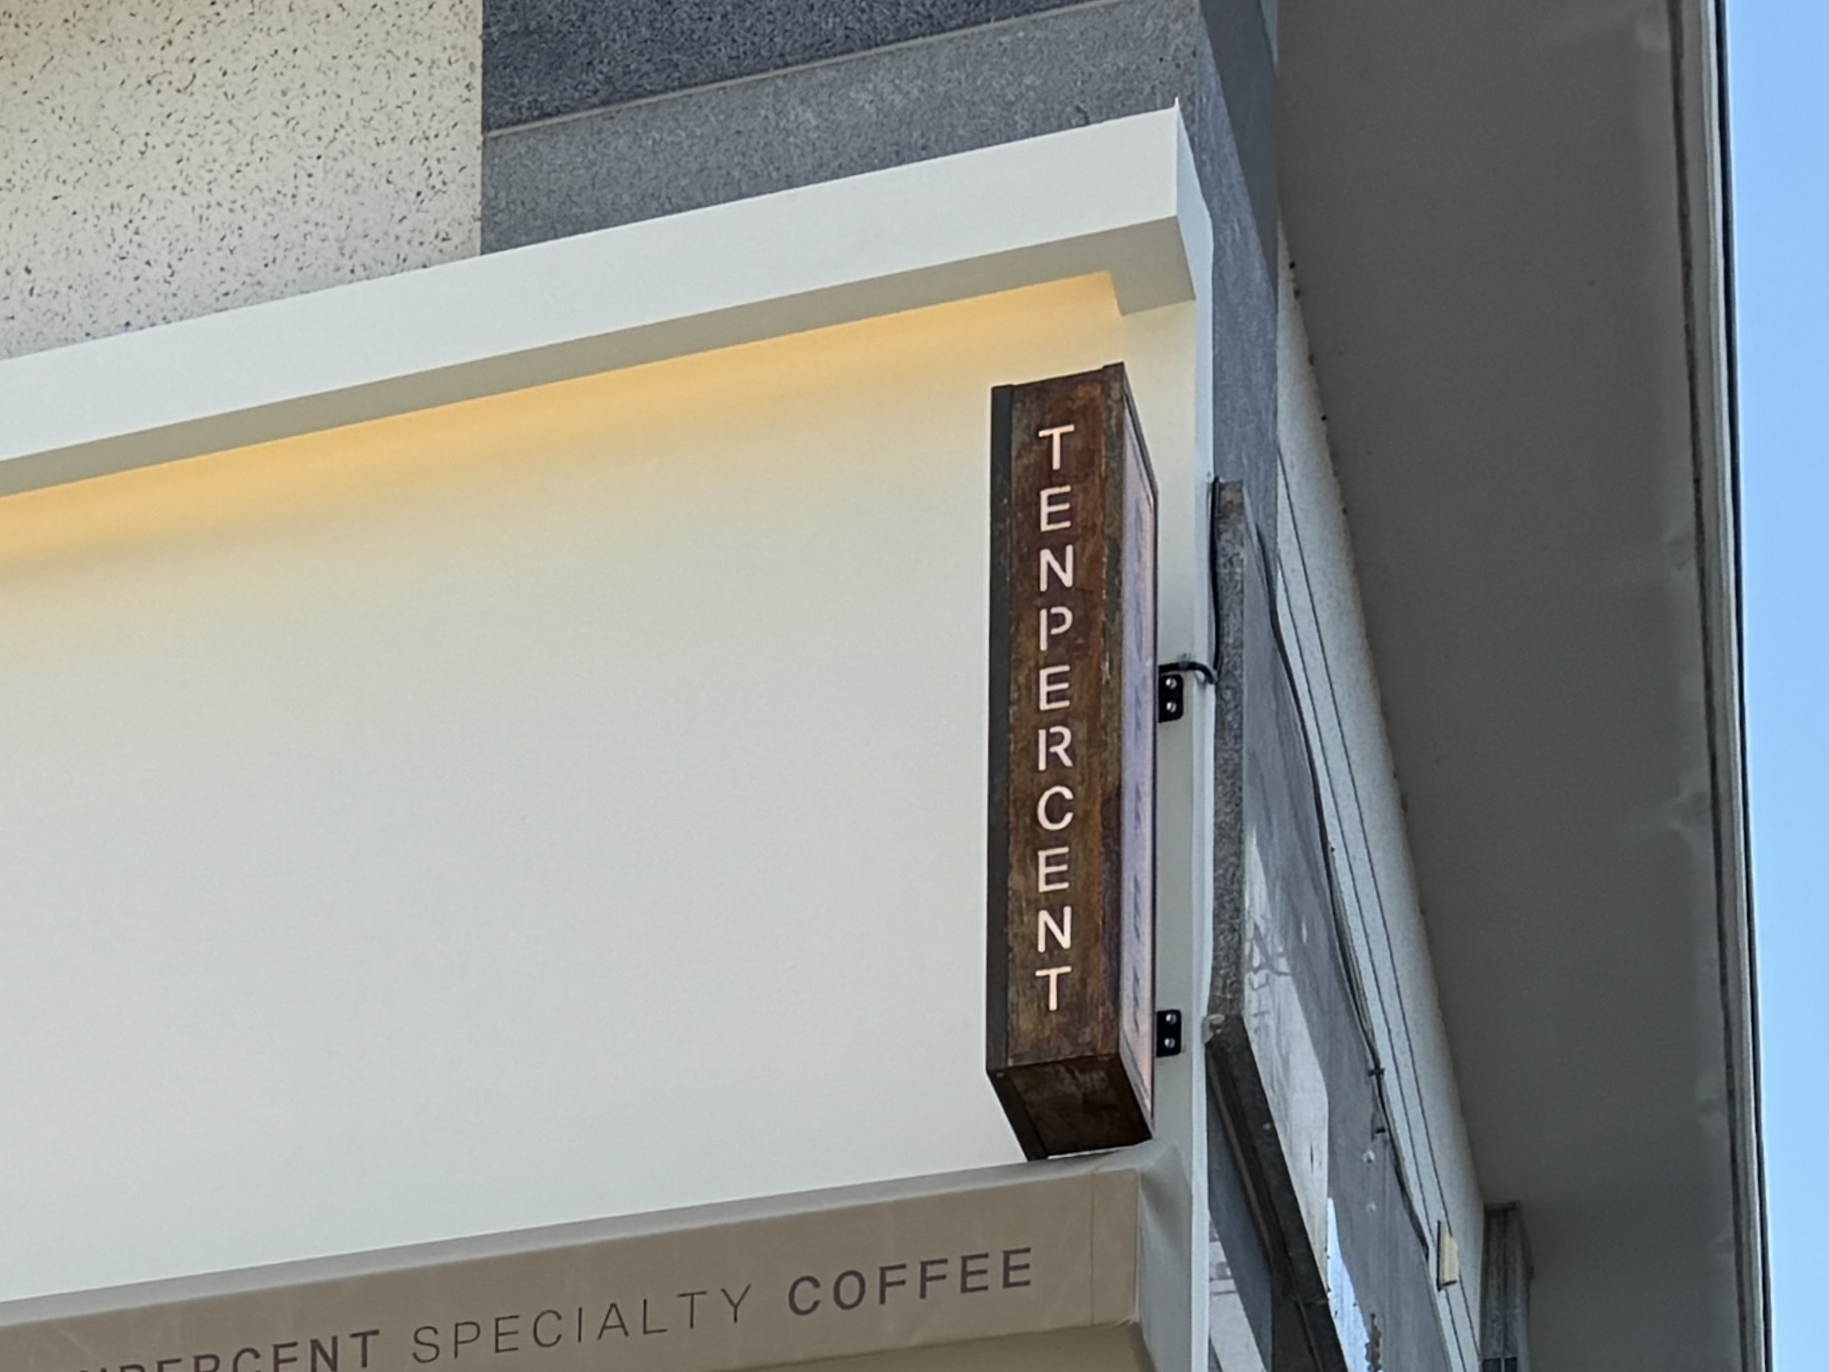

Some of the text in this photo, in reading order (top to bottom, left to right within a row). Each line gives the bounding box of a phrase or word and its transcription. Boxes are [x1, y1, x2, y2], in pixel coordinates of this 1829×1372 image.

[1034, 423, 1076, 1012] TENPERCENT
[410, 1283, 753, 1365] SPECIALTY
[786, 1246, 1036, 1318] COFFEE
